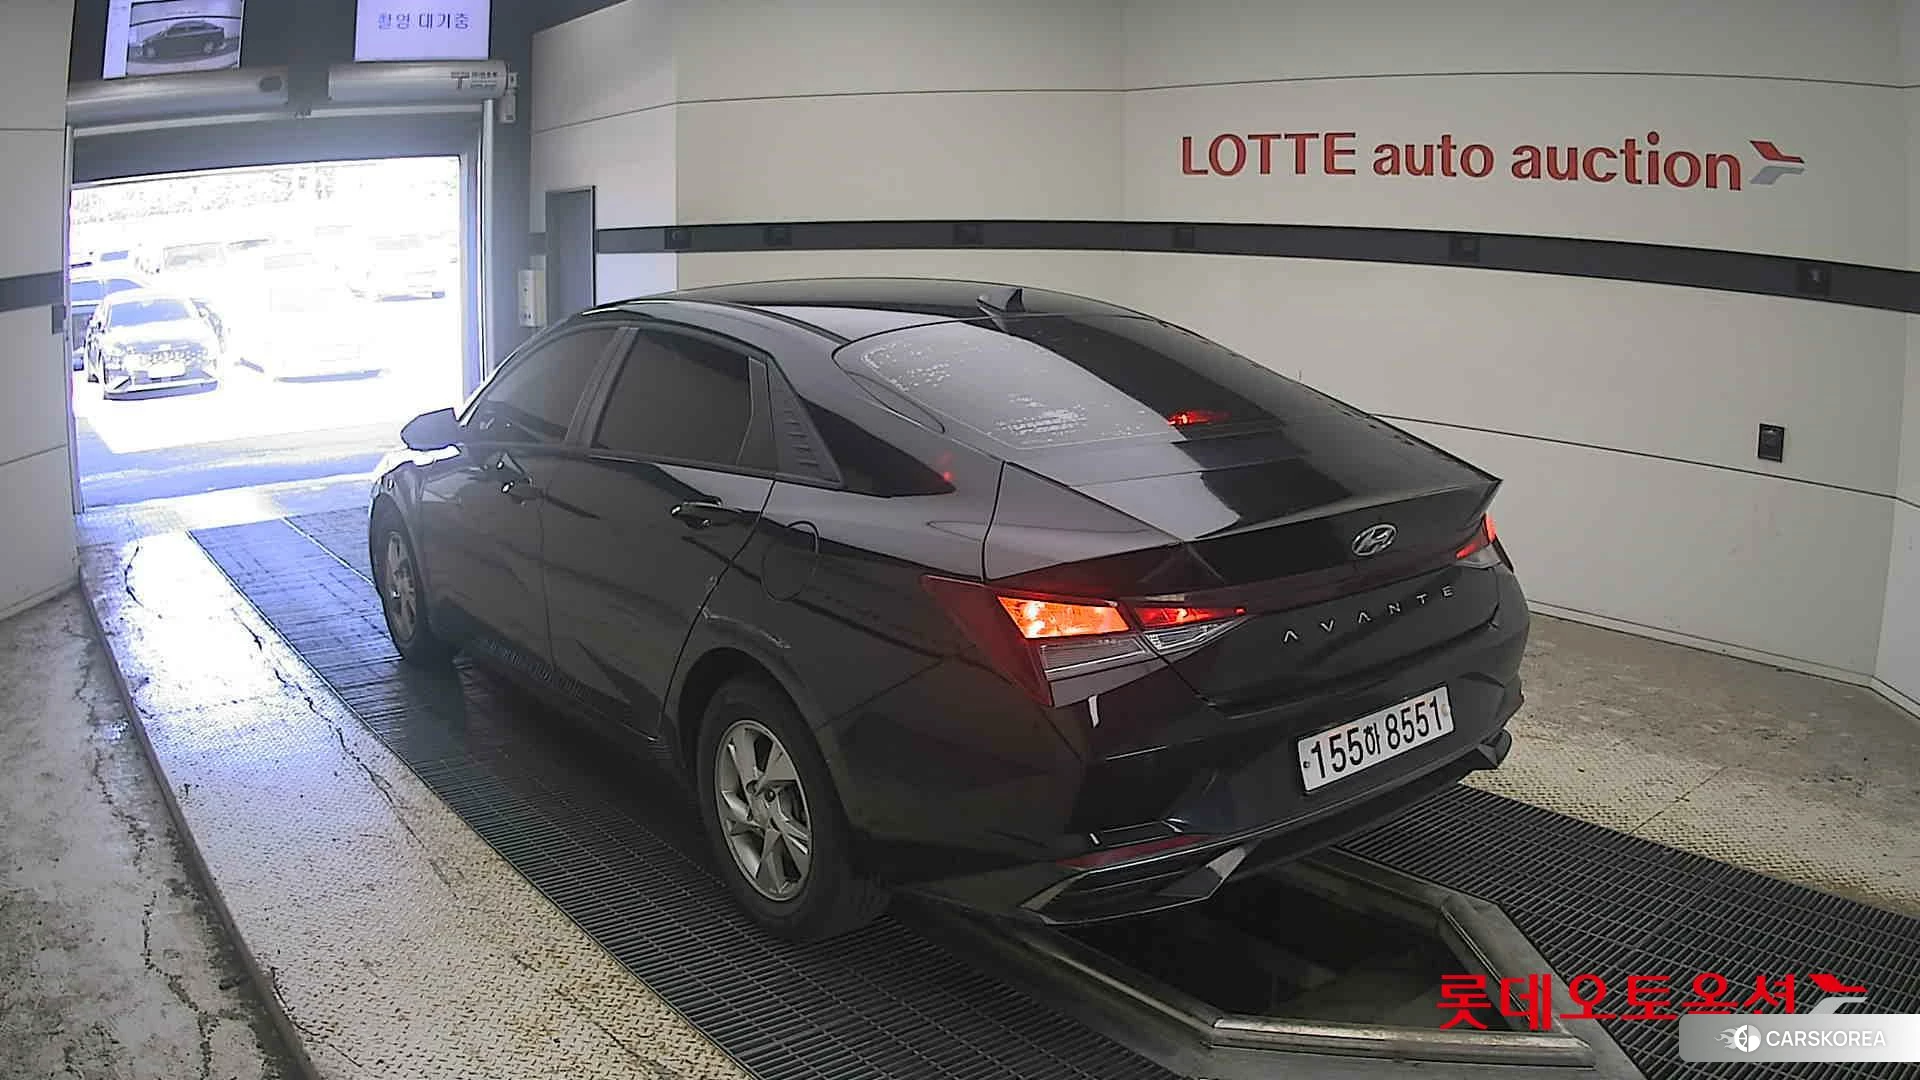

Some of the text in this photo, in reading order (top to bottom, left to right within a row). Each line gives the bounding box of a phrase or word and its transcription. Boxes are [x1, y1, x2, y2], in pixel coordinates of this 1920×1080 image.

[1182, 132, 1742, 190] LOTTE auto auction
[1283, 585, 1454, 643] AVANTE
[1311, 695, 1443, 779] 155하 8551
